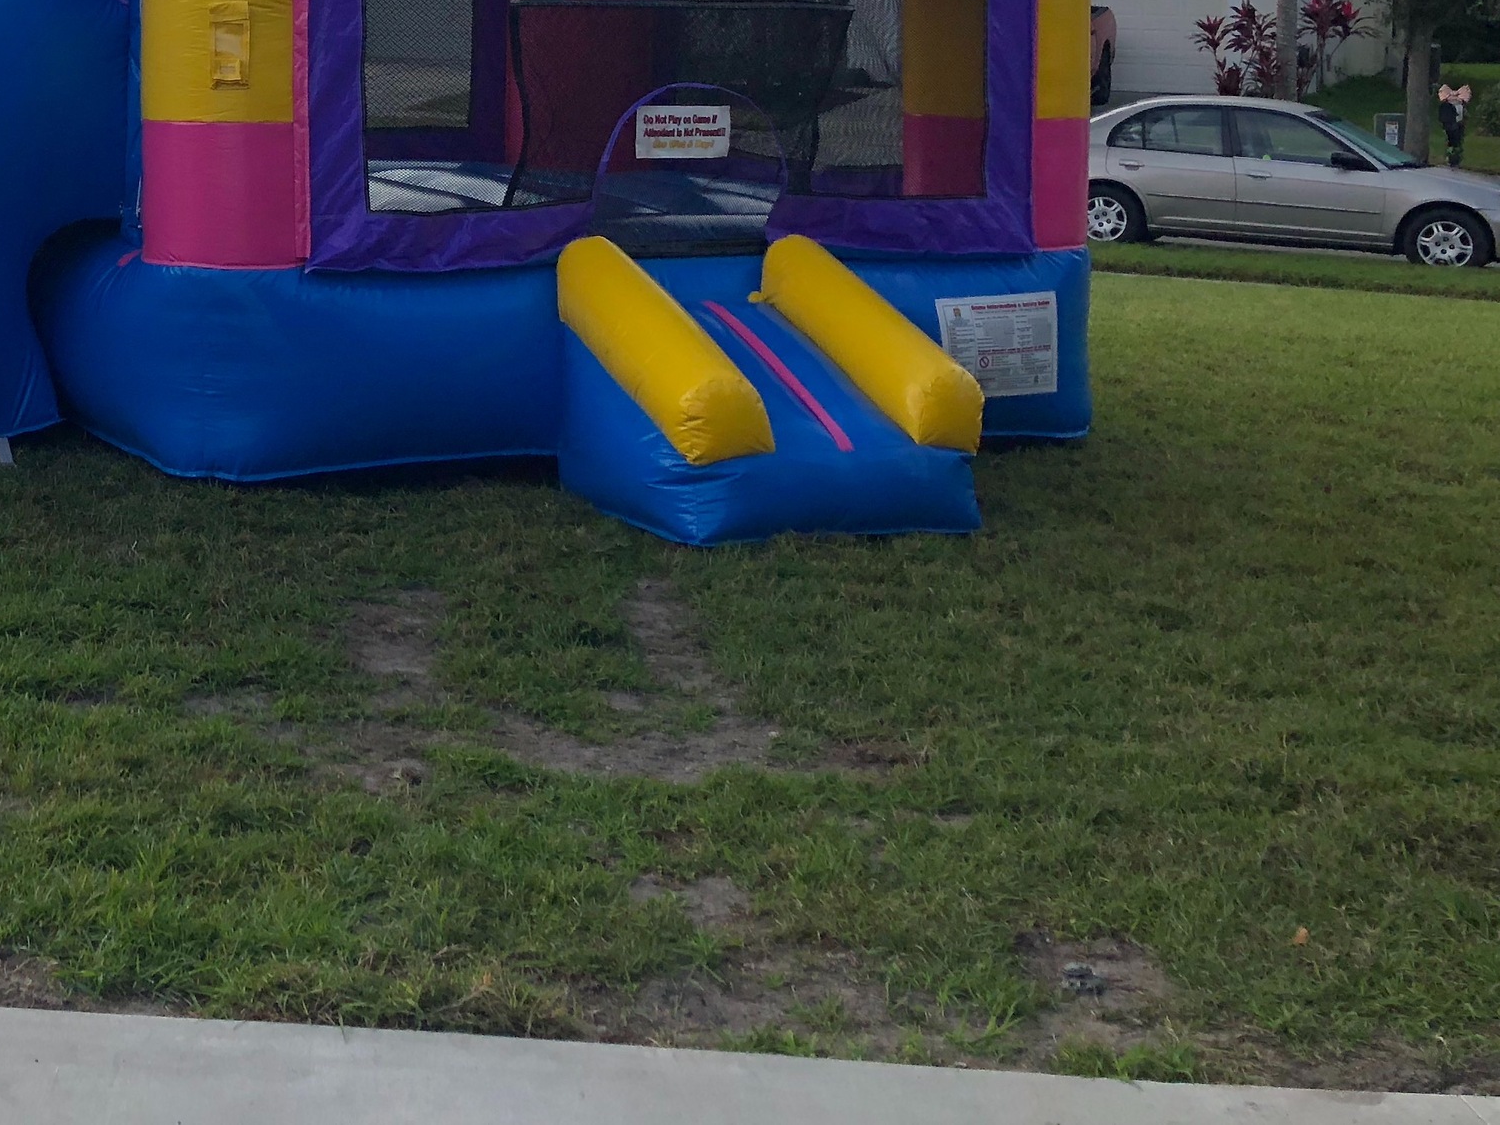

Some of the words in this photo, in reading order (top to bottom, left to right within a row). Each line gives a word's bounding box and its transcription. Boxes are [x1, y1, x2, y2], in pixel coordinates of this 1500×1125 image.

[643, 115, 654, 124] Do
[655, 115, 667, 124] Not
[668, 115, 682, 126] Play
[683, 116, 691, 124] on
[692, 115, 711, 124] Game
[684, 128, 694, 137] Not
